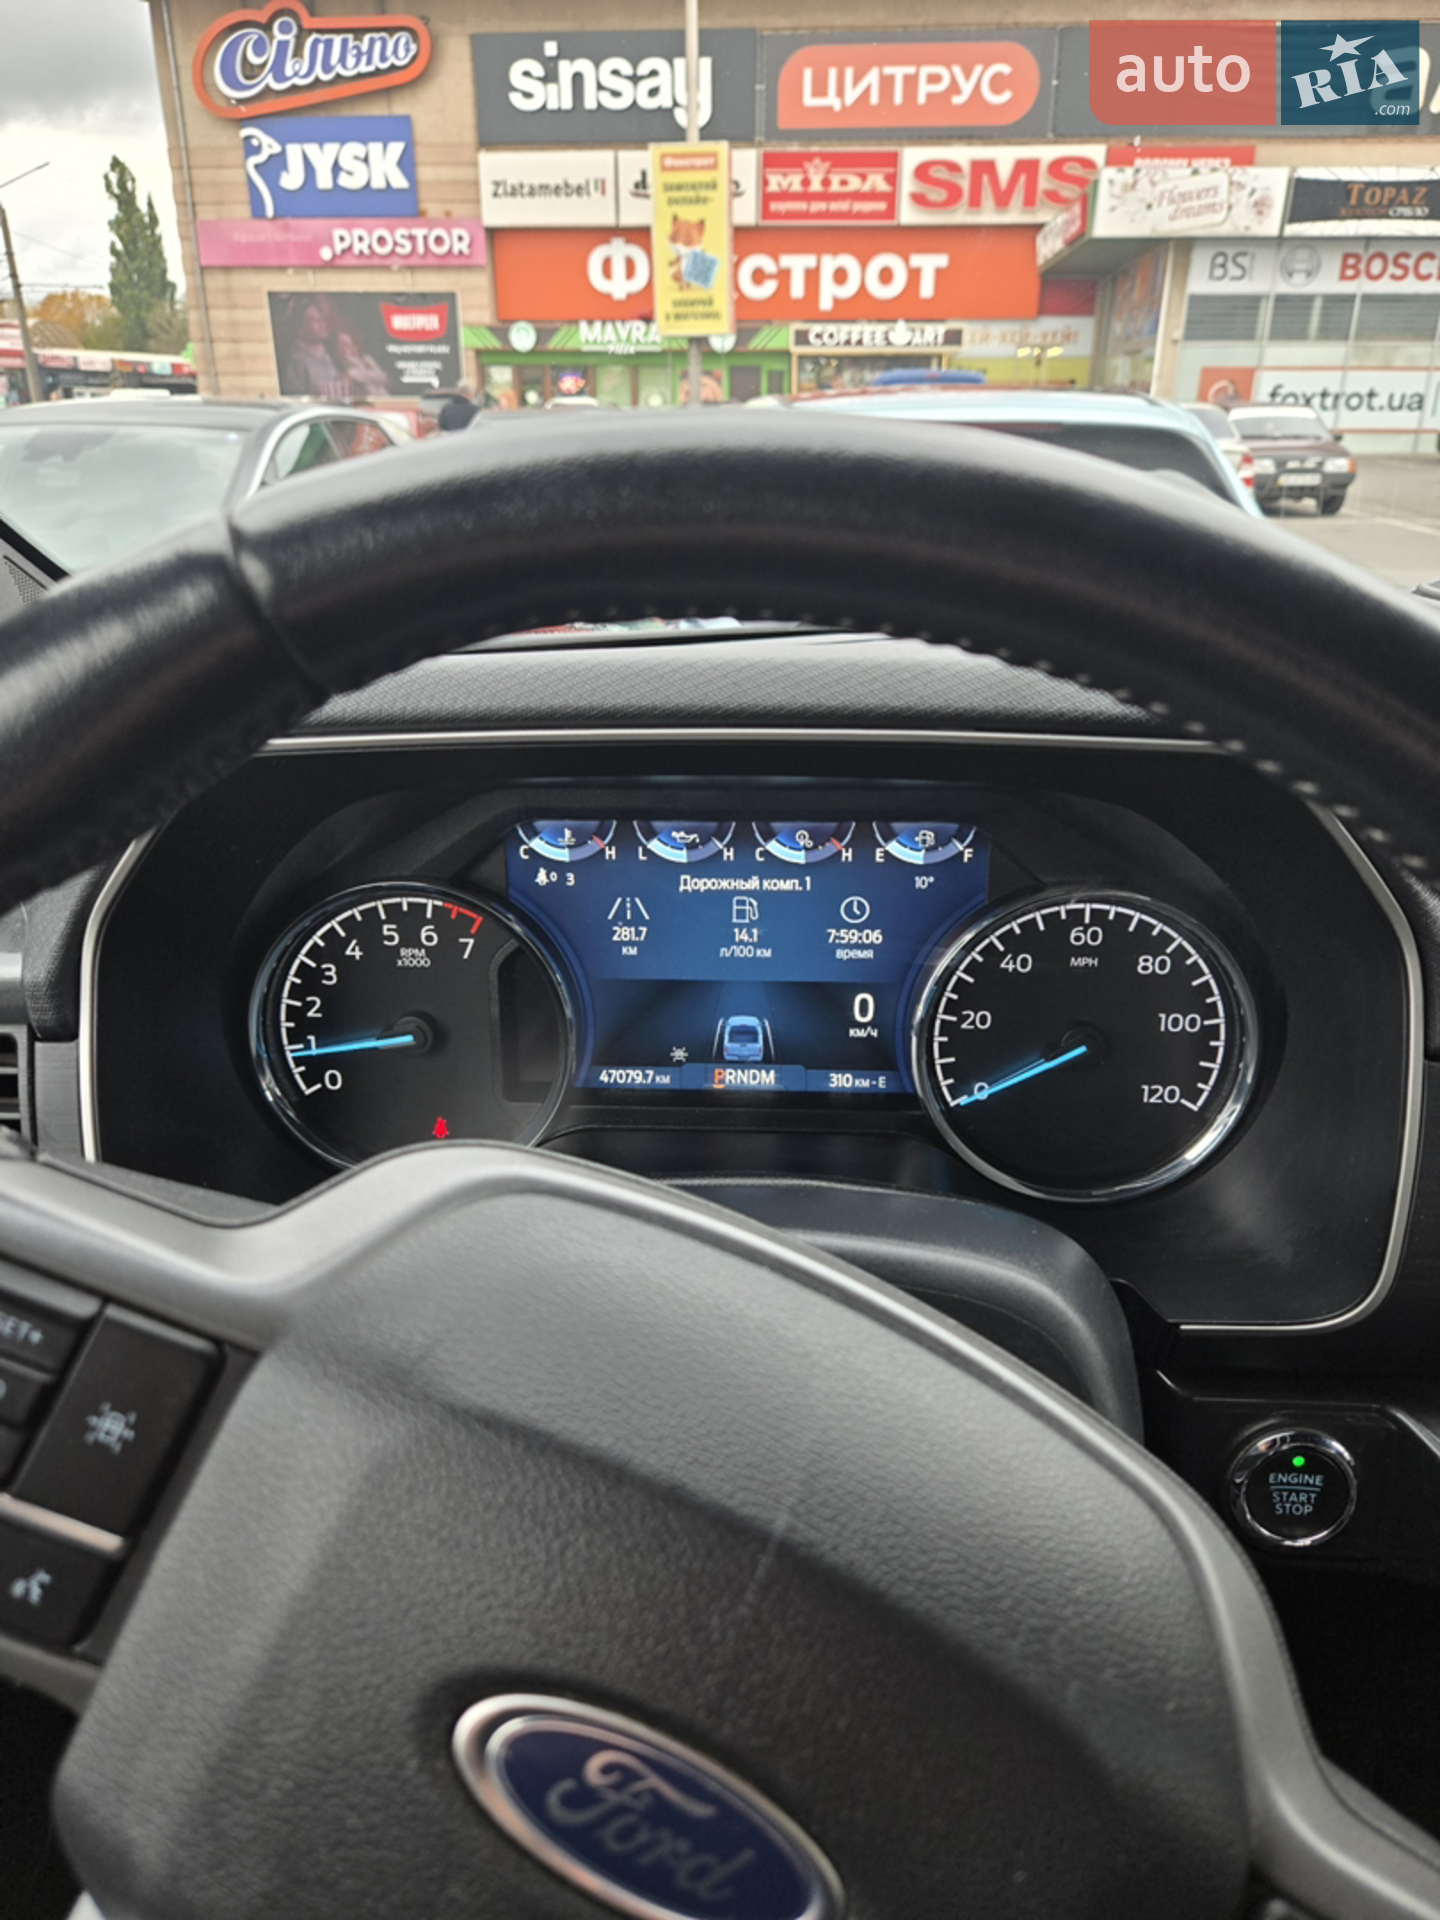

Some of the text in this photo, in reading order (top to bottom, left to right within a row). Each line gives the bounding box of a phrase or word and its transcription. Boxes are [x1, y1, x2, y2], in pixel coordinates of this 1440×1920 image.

[214, 16, 417, 98] Сільпо
[508, 40, 713, 129] sinsay
[802, 63, 1014, 111] ЦИТРУС
[279, 142, 410, 191] JYSK
[491, 178, 592, 198] Zlatamebel
[764, 172, 893, 193] MIDA
[910, 157, 1098, 208] SMS
[1347, 184, 1428, 206] TOPAZ
[586, 237, 949, 312] Фстрот
[1339, 251, 1440, 282] BOSC
[578, 320, 663, 344] MAVRA
[809, 324, 888, 346] COFFEE
[679, 873, 812, 892] Дорожный комп. 1
[382, 924, 399, 946] 5
[420, 925, 438, 946] 6
[612, 926, 647, 941] 281.7
[733, 928, 758, 942] 14.1
[827, 930, 882, 944] 7:59:06
[1069, 927, 1103, 946] 60
[345, 939, 363, 960] 4
[400, 947, 426, 957] RPM
[458, 938, 475, 959] 7
[621, 946, 638, 956] км
[719, 945, 772, 958] л/100 км
[835, 948, 874, 960] время
[397, 957, 431, 968] x1000
[1000, 953, 1032, 973] 40
[1070, 957, 1098, 967] MPH
[1136, 955, 1171, 975] 80
[321, 964, 338, 985] 3
[306, 996, 323, 1017] 2
[853, 993, 875, 1023] 0
[960, 1010, 992, 1030] 20
[1158, 1013, 1201, 1032] 100
[849, 1026, 878, 1038] км/ч
[324, 1069, 343, 1091] 0
[599, 1069, 654, 1084] 47079.7
[713, 1068, 776, 1086] PRNDM
[828, 1073, 853, 1088] 310
[1141, 1084, 1180, 1103] 120
[1268, 1472, 1324, 1486] ENGINE
[1272, 1491, 1317, 1504] START
[1275, 1503, 1313, 1516] STOP
[545, 1750, 755, 1898] Ford
